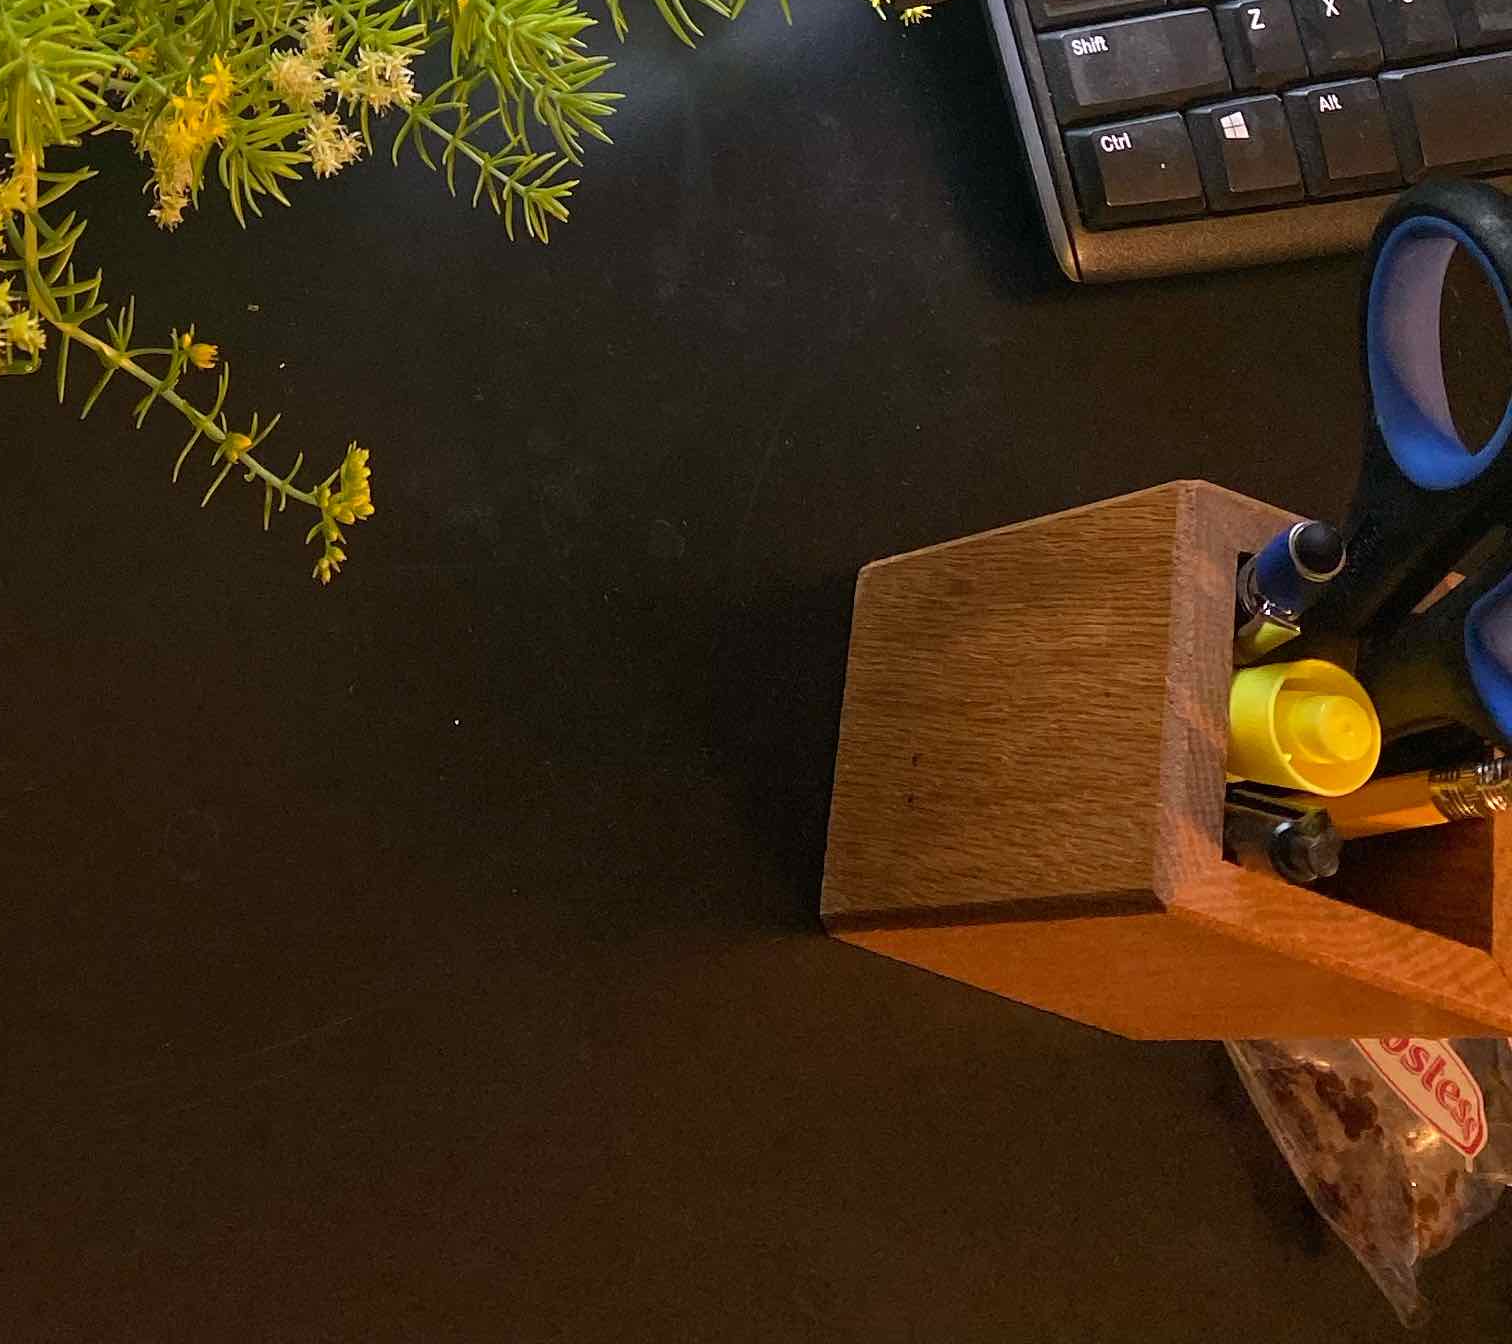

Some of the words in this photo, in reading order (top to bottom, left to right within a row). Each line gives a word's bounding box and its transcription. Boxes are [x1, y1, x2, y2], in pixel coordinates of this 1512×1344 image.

[1071, 35, 1109, 56] Shift
[1247, 7, 1265, 31] Z
[1100, 132, 1133, 153] Ctrl
[1318, 93, 1342, 113] Alt
